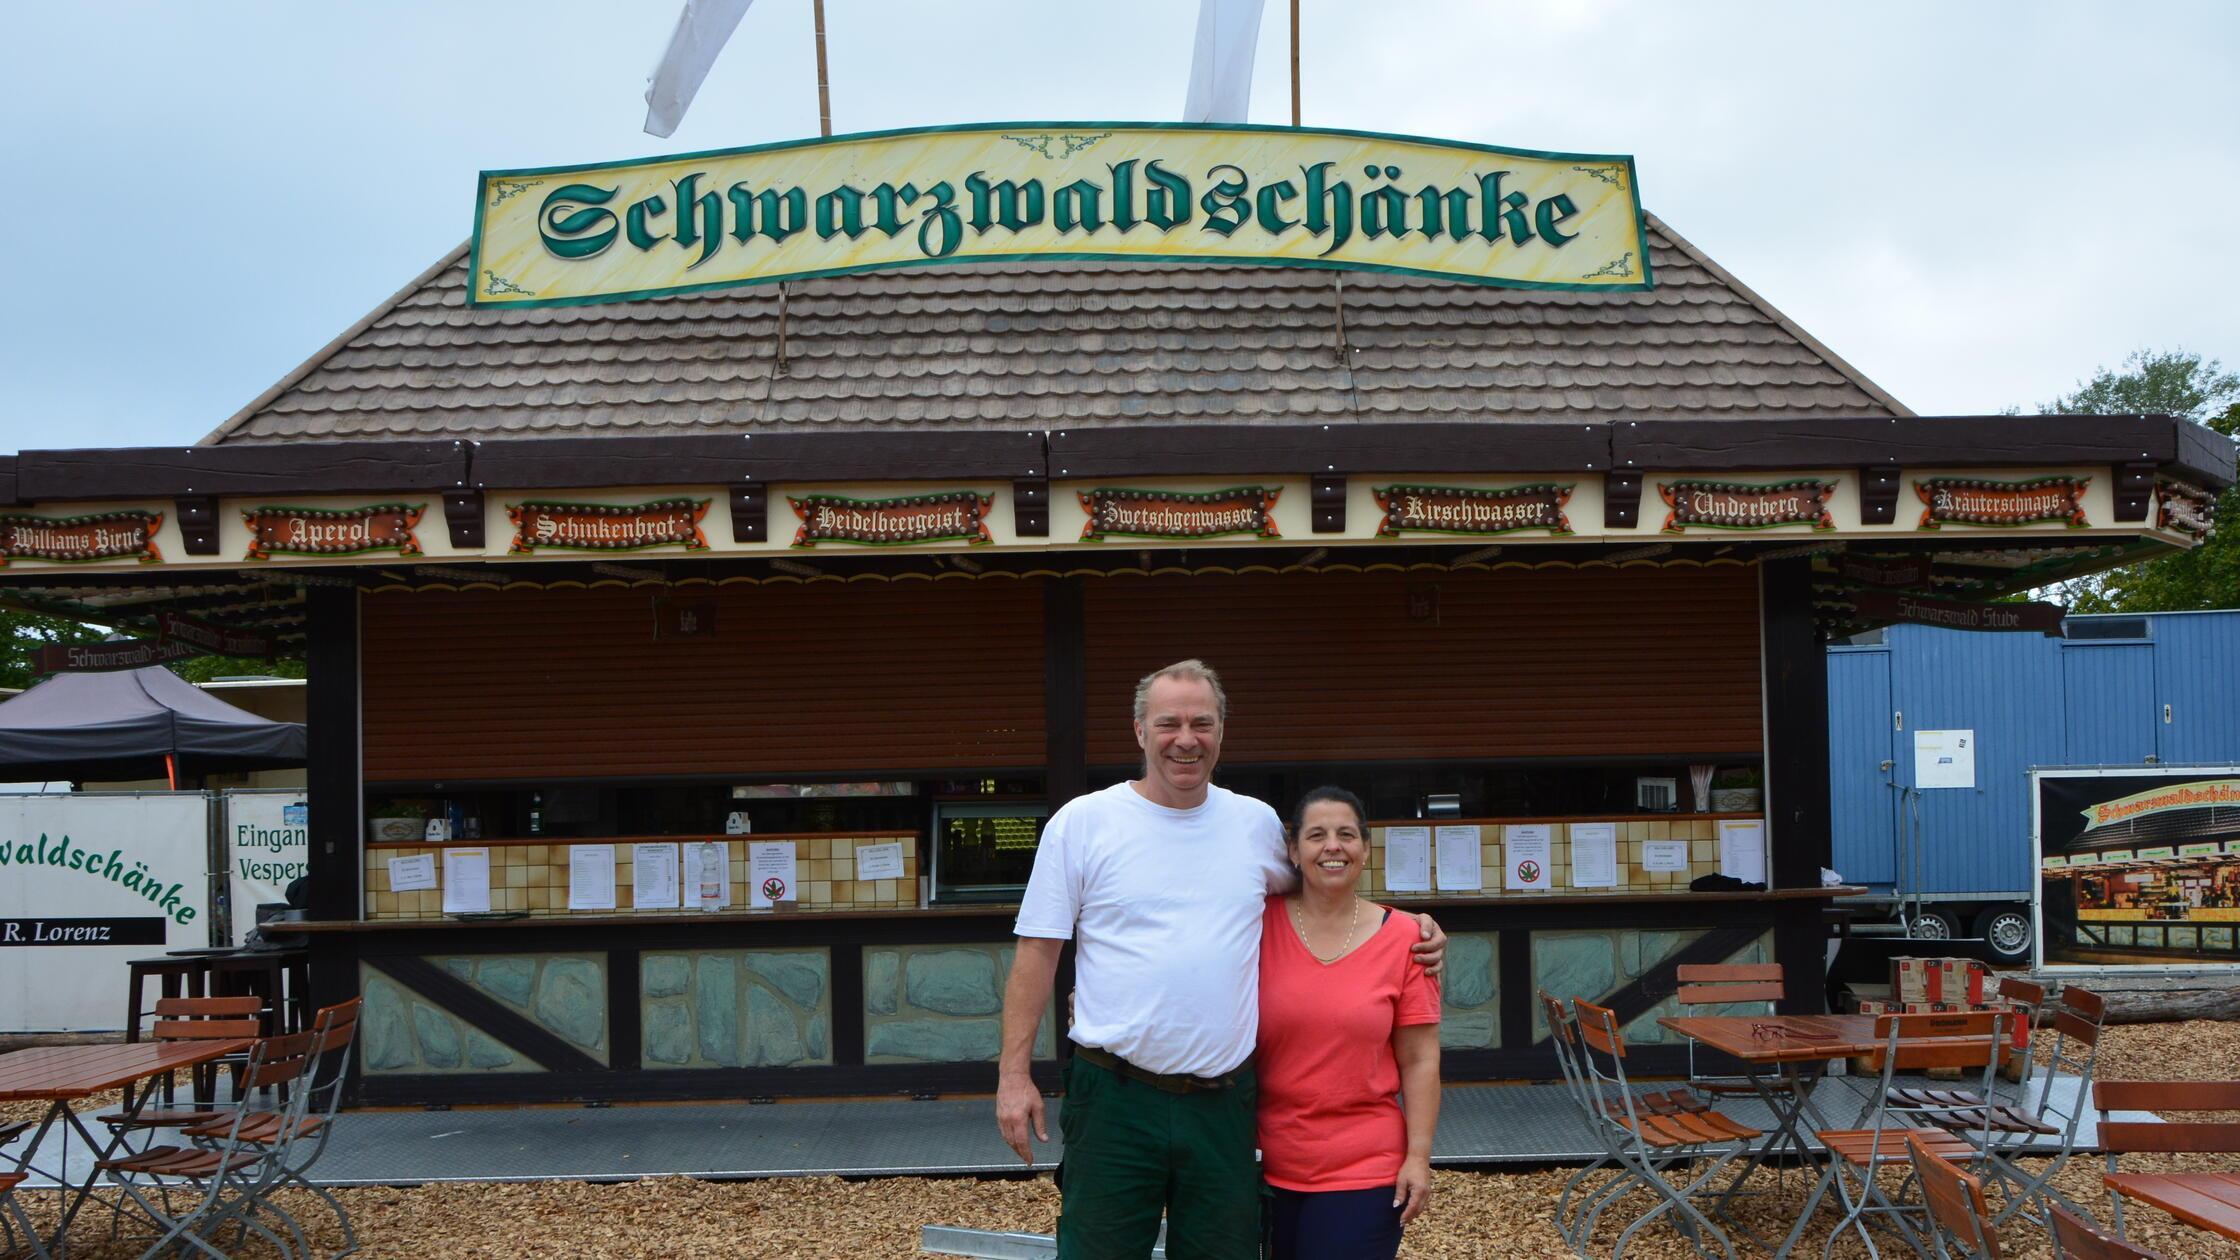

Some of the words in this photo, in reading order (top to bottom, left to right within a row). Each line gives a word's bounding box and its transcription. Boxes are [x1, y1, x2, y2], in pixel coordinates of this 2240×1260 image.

[538, 156, 1582, 271] Schwarzwaldschänke
[1405, 496, 1544, 525] Kirschwasser
[1693, 491, 1799, 517] Underberg
[1935, 488, 2060, 515] Kräuterschnaps
[536, 514, 676, 540] Schinkenbrot
[816, 505, 963, 534] Heidelbeergeist
[1104, 500, 1253, 531] Zwetschgenwasser
[12, 526, 89, 550] Williams
[95, 527, 143, 549] Birne
[289, 517, 370, 548] Aperol
[1983, 607, 2020, 627] Stube
[4, 922, 26, 942] R.
[34, 922, 111, 942] Lorenz
